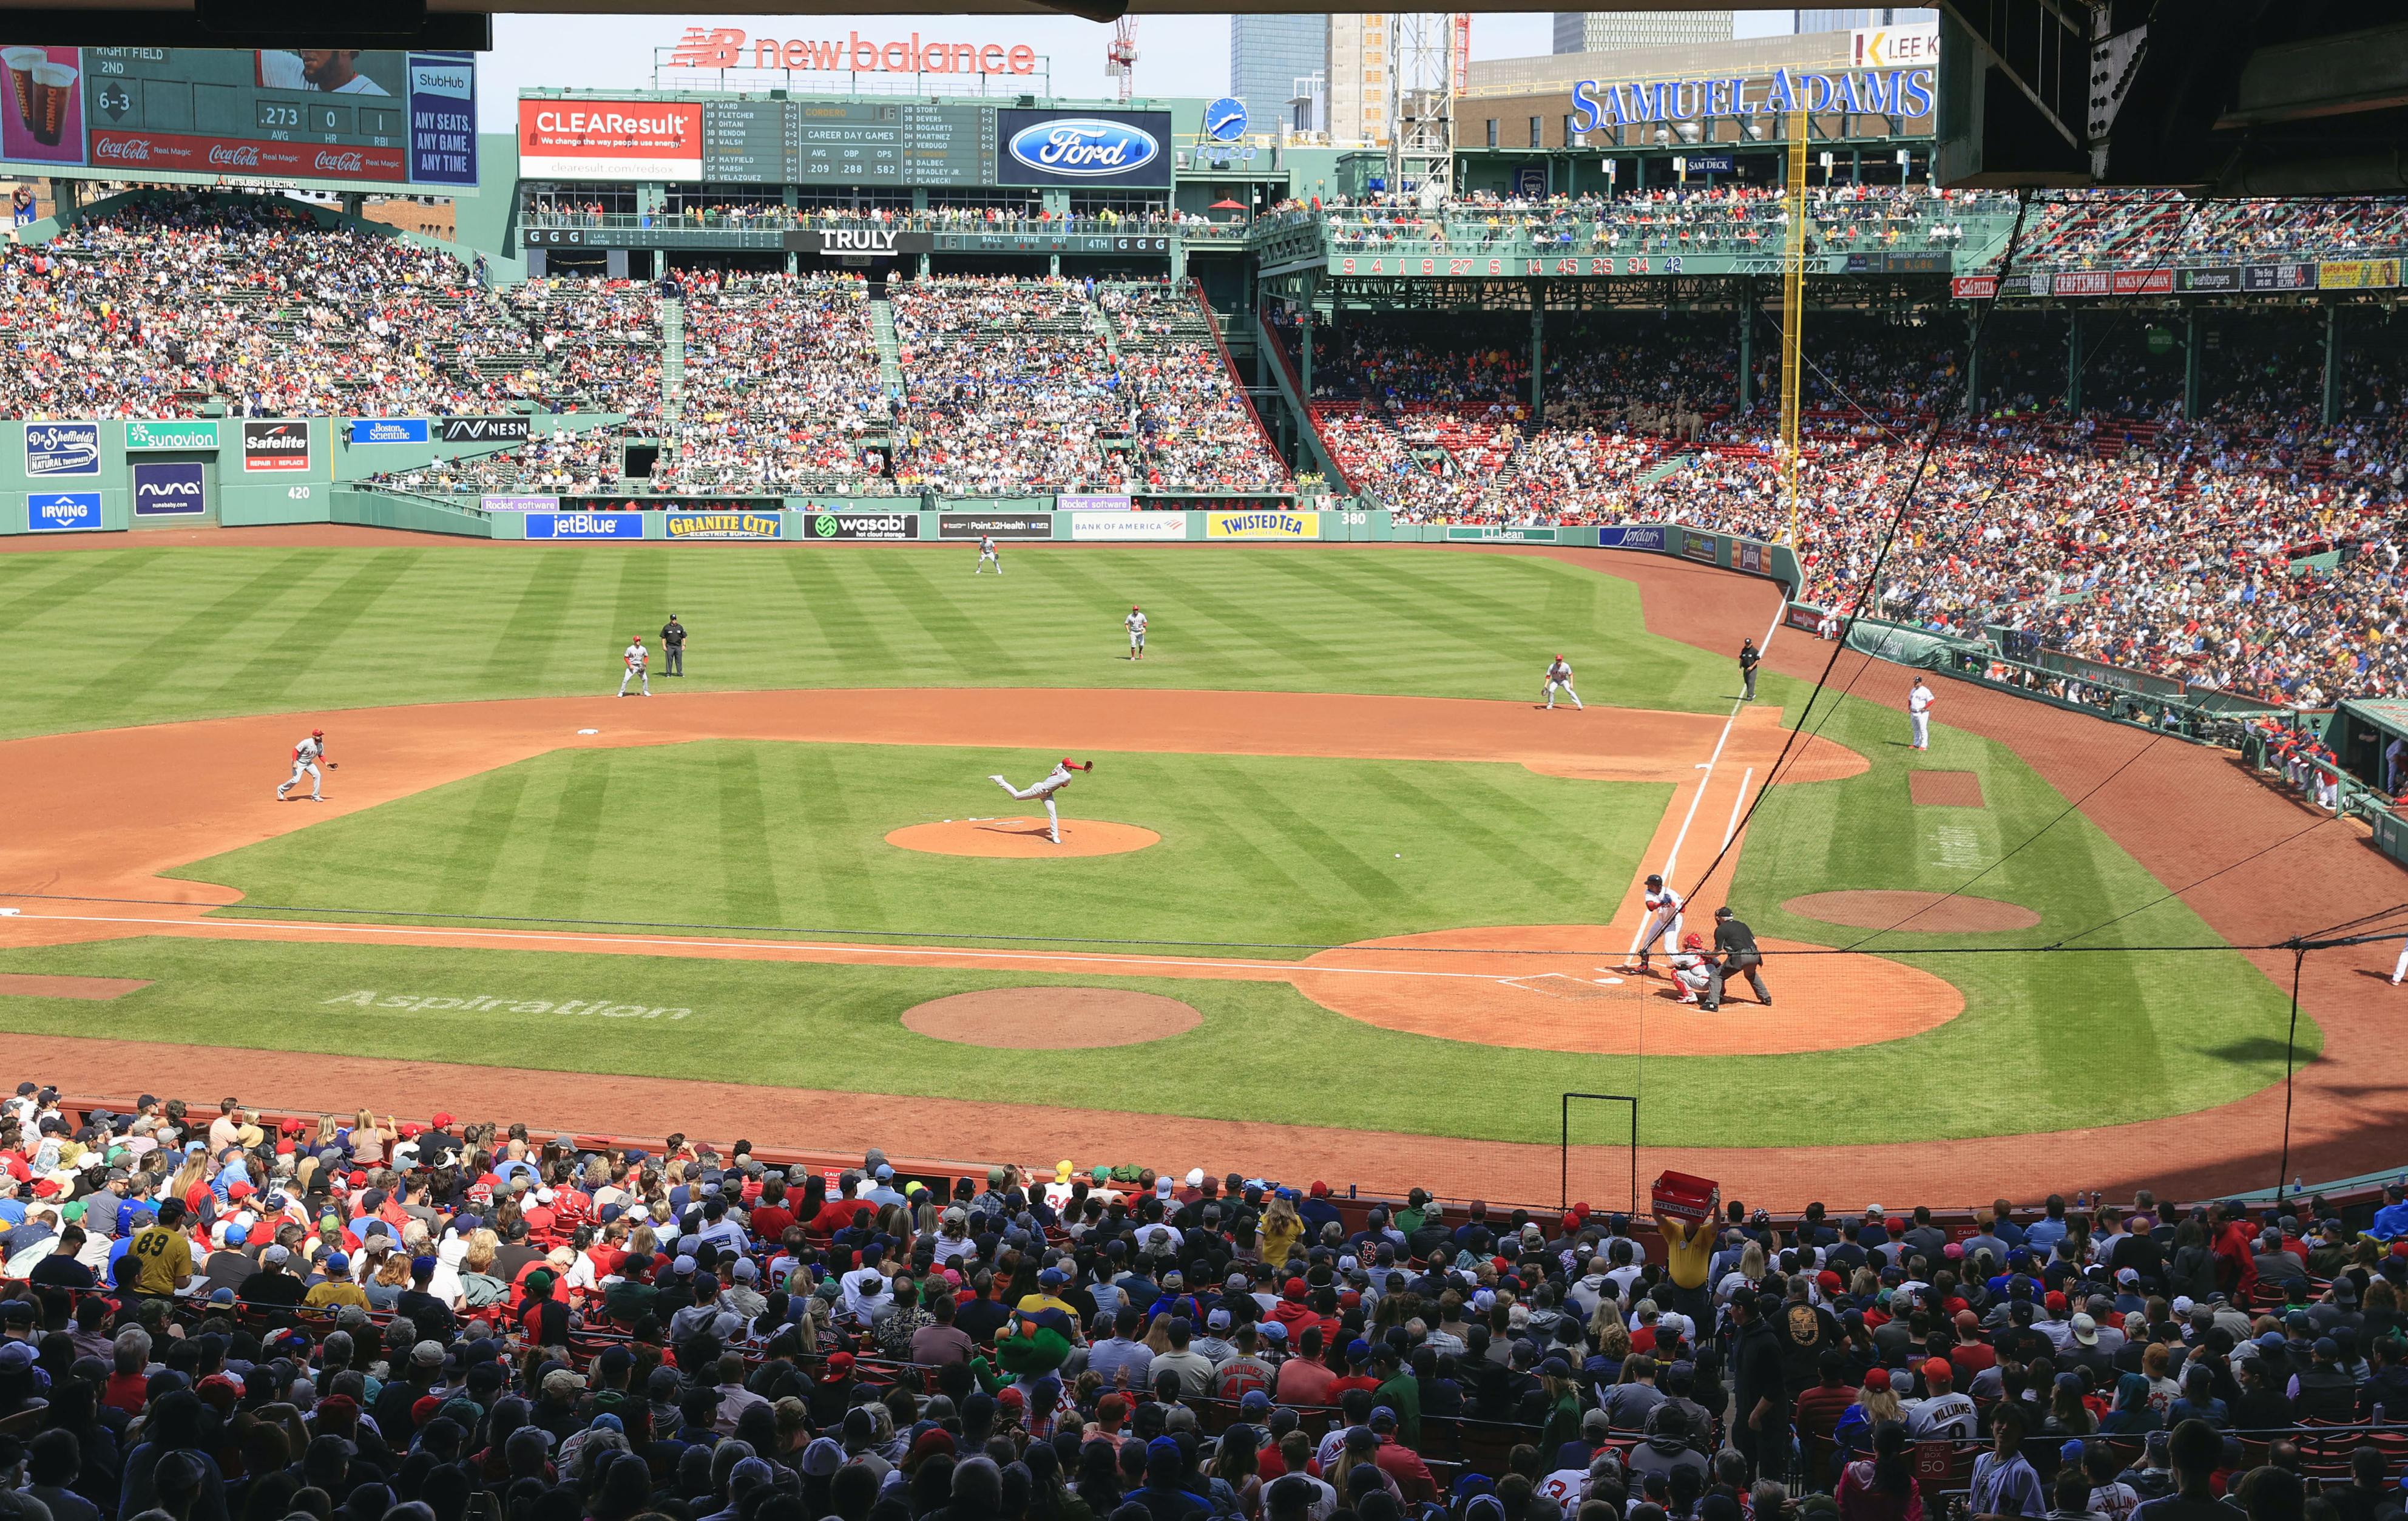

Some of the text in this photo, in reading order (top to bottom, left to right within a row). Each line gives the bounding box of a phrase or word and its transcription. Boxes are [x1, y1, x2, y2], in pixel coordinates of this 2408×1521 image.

[96, 48, 163, 59] RIGHT FIELD
[755, 31, 1035, 75] new balance
[1889, 37, 1921, 59] LEE
[102, 62, 124, 75] 2ND
[419, 73, 464, 89] StubHub
[99, 92, 130, 110] 6-3
[1571, 67, 1934, 134] SAMUEL ADAMS
[46, 87, 57, 134] DUNKIN'
[261, 107, 298, 125] .273
[326, 112, 336, 127] 0
[416, 112, 472, 134] ANY SEATS,
[537, 112, 685, 135] CLEAResult
[271, 131, 388, 147] AVG HR RBI
[418, 132, 470, 154] ANY GAME,
[541, 137, 553, 146] We
[555, 138, 581, 147] change
[597, 140, 612, 148] way
[613, 138, 639, 149] people
[654, 140, 681, 149] energy.
[1040, 126, 1129, 168] Ford
[96, 137, 150, 160] Coca-Cola
[171, 147, 192, 157] Magic
[209, 144, 259, 166] Coca-Cola
[279, 154, 300, 163] Magic
[1195, 143, 1257, 165] tyco
[314, 151, 362, 172] Coca-Cola
[381, 160, 400, 168] Magic
[422, 154, 467, 172] ANY TIME
[551, 162, 674, 174] clearesult.com/redsox
[808, 164, 895, 174] .209 .288 .582
[1688, 160, 1728, 171] SAM DECK
[228, 178, 265, 188] MITSUBISHI
[819, 229, 898, 249] TRULY
[1089, 239, 1108, 249] 4TH
[1343, 257, 1683, 275] 9 4 1 8 27 6 14 45 26 34 42
[1973, 280, 1994, 296] PIZZA
[2055, 274, 2107, 293] CRAFTSMAN
[2193, 273, 2230, 288] wahlburgers
[369, 429, 410, 441] Scientific
[374, 422, 401, 432] Boston
[489, 423, 527, 436] NESN
[29, 432, 45, 446] Dr.
[147, 433, 214, 447] sunovion
[246, 436, 306, 450] Safelite
[31, 456, 89, 470] NATURAL TOOTHPASTE
[139, 483, 200, 496] nuna
[288, 486, 310, 500] 420
[42, 505, 88, 518] IRVING
[485, 500, 555, 510] Rocket software
[1061, 499, 1127, 510] Rocket software
[552, 515, 618, 537] jetBlue
[669, 515, 779, 535] GRANITE CITY
[839, 515, 905, 532] wasabi
[970, 521, 1026, 530] Point32Health
[1222, 514, 1303, 535] TWISTED TEA
[1342, 512, 1366, 524] 380
[1619, 528, 1659, 546] Jordan's
[1742, 550, 1759, 569] KAYEM
[320, 989, 692, 1020] Aspiration
[137, 1233, 169, 1257] 89
[1222, 1364, 1265, 1380] MARTINEZ
[1932, 1403, 1972, 1424] WILLIAMS
[1920, 1460, 1945, 1472] 50
